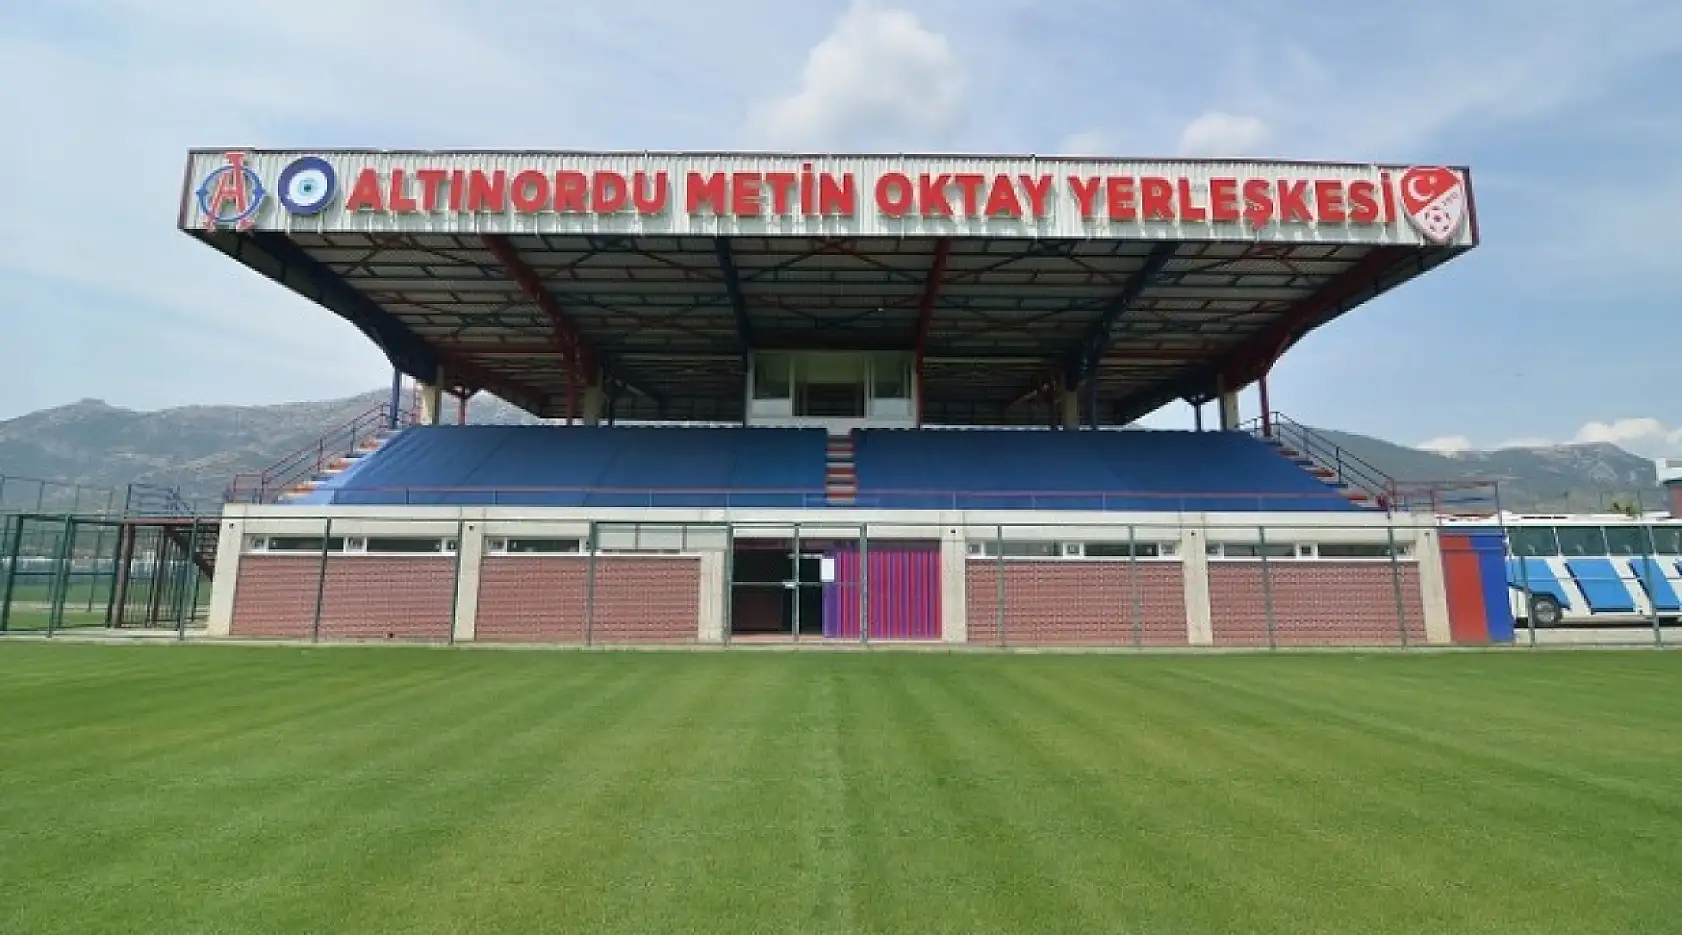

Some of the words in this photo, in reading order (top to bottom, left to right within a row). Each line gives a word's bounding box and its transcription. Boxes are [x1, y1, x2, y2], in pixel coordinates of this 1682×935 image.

[347, 167, 668, 213] ALTINORDU
[685, 163, 856, 216] METİN
[874, 171, 1053, 217] OKTAY
[1069, 173, 1397, 227] YERLEŞKESİ
